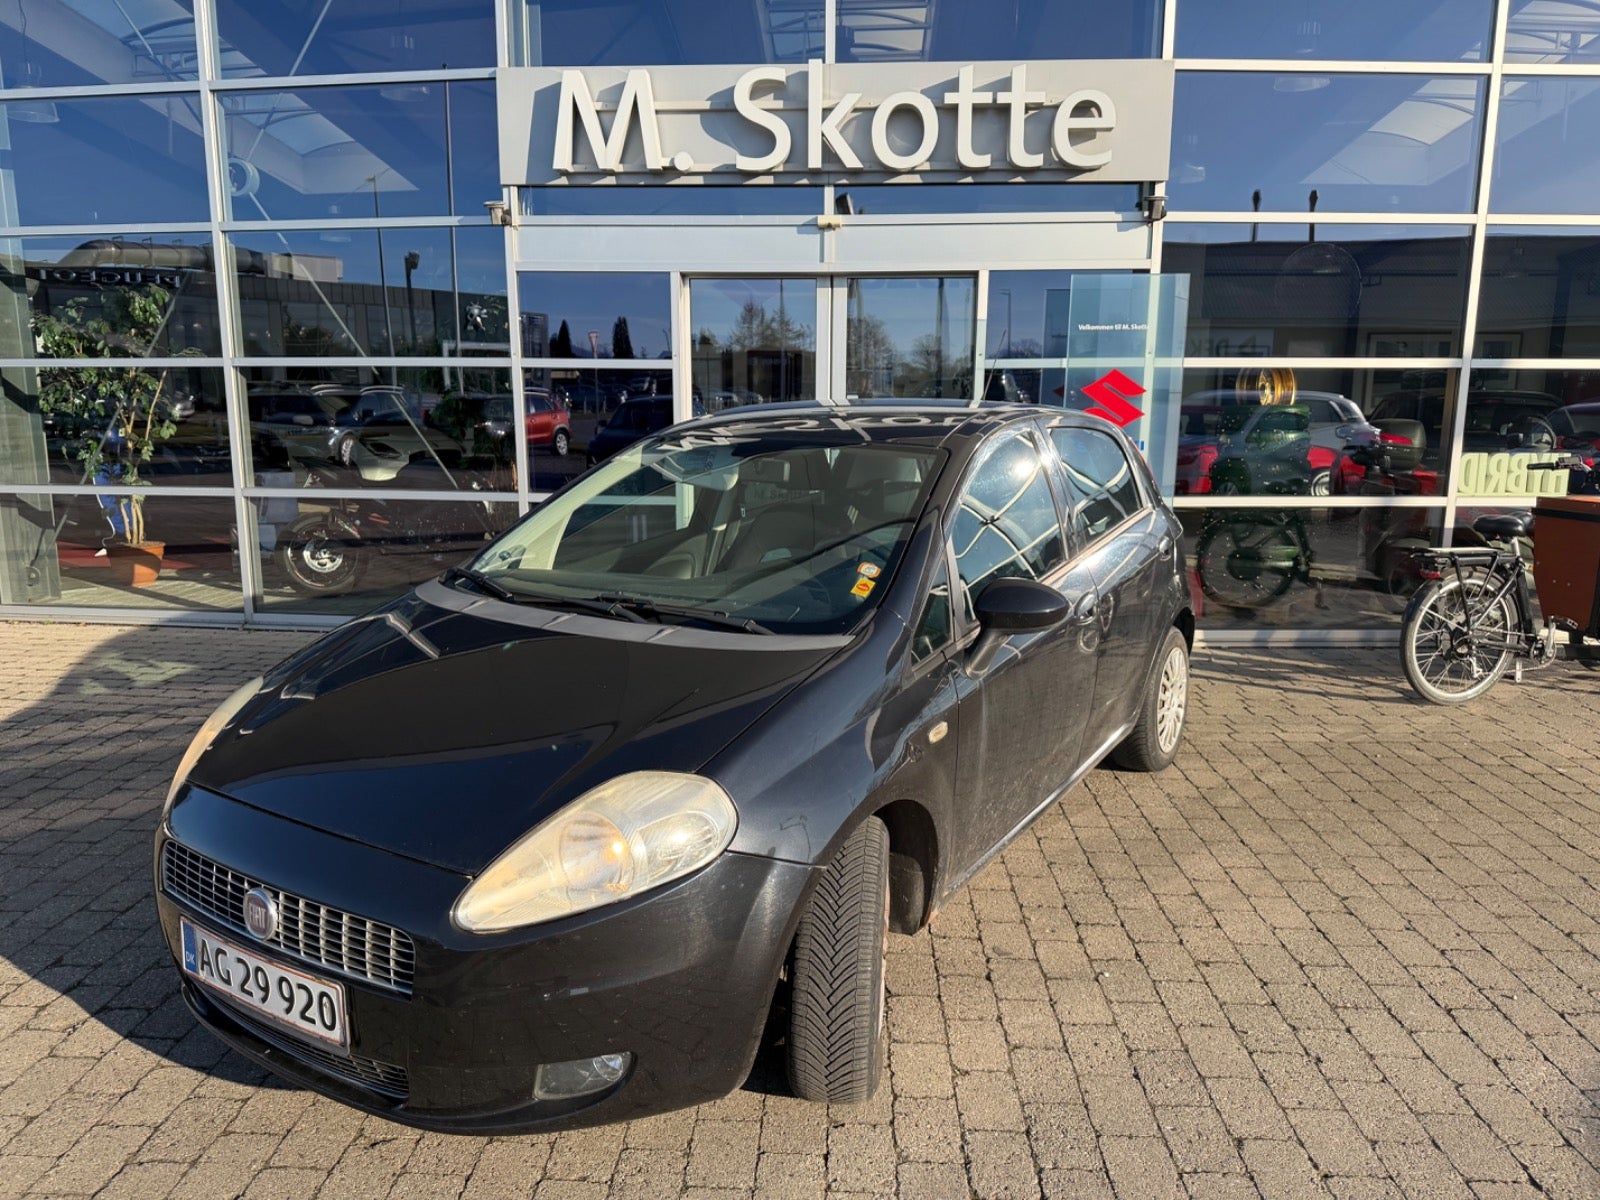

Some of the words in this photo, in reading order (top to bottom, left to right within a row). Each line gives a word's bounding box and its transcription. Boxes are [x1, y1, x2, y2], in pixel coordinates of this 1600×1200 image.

[552, 67, 694, 174] M.
[733, 58, 1118, 172] Skotte
[1078, 323, 1114, 331] Velkommen
[248, 902, 267, 929] FIAT
[185, 950, 196, 966] DK
[200, 938, 234, 987] AG
[236, 957, 271, 1004] 29
[278, 976, 337, 1032] 920
